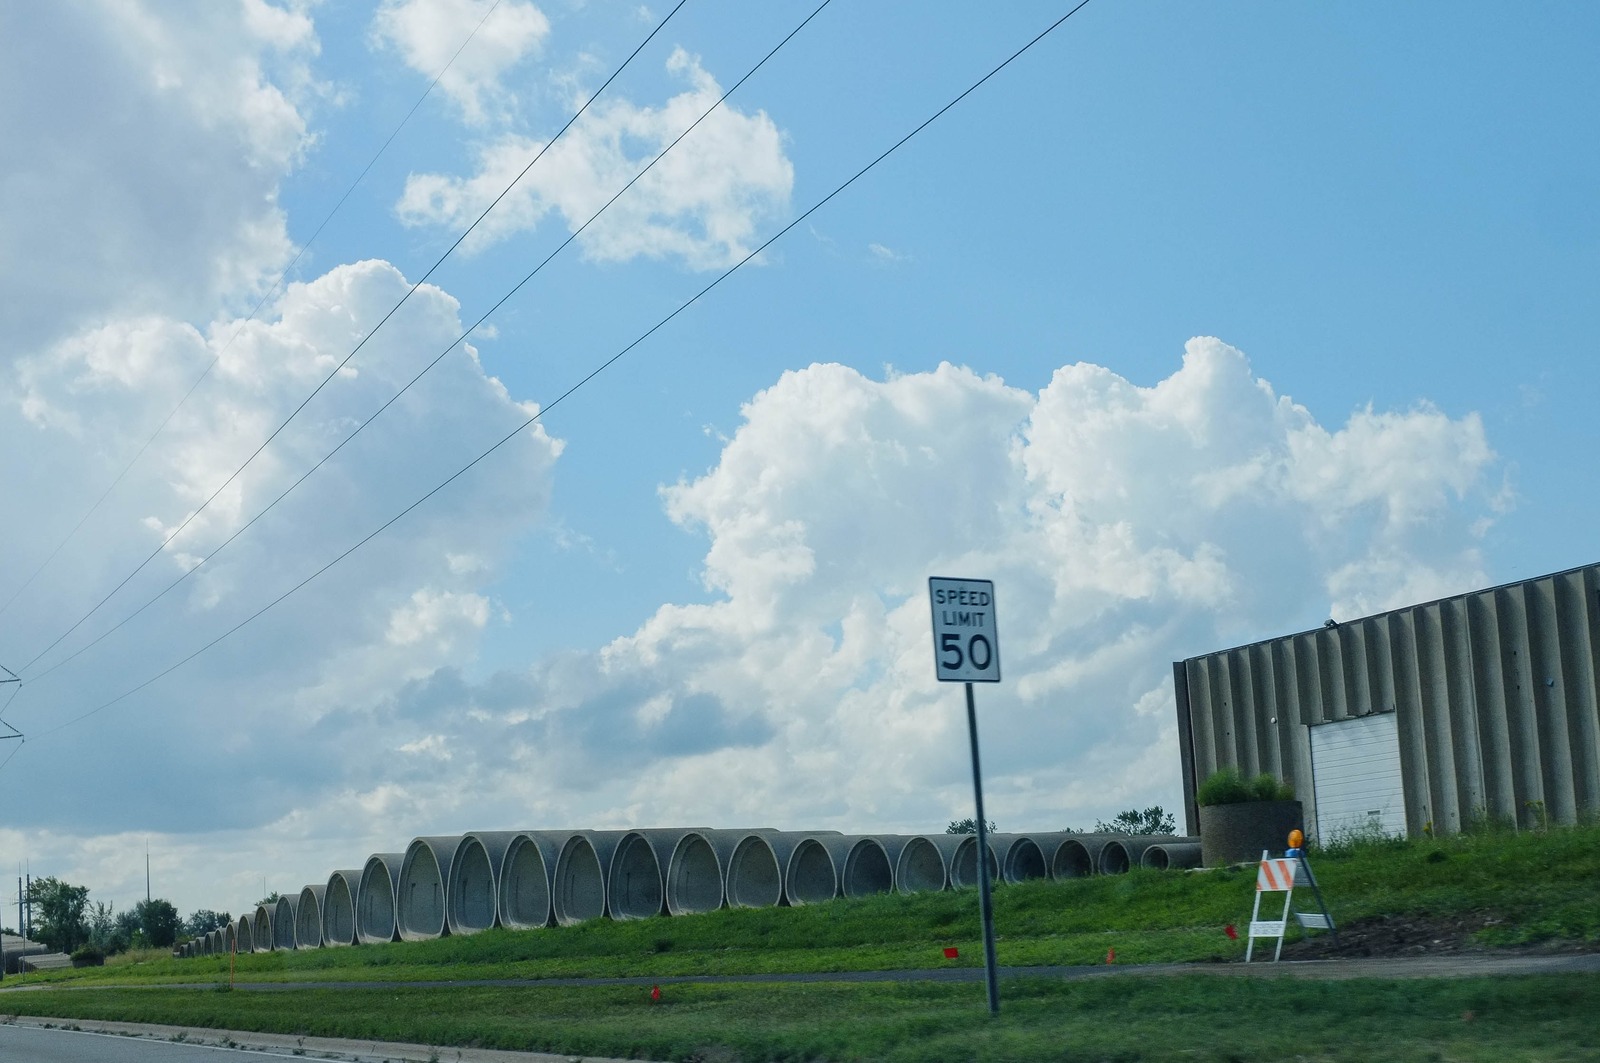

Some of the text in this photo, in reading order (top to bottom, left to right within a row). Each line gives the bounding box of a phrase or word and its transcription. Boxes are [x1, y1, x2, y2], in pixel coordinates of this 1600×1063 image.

[936, 589, 990, 606] SPEED
[942, 611, 985, 627] LIMIT
[941, 633, 991, 670] 50
